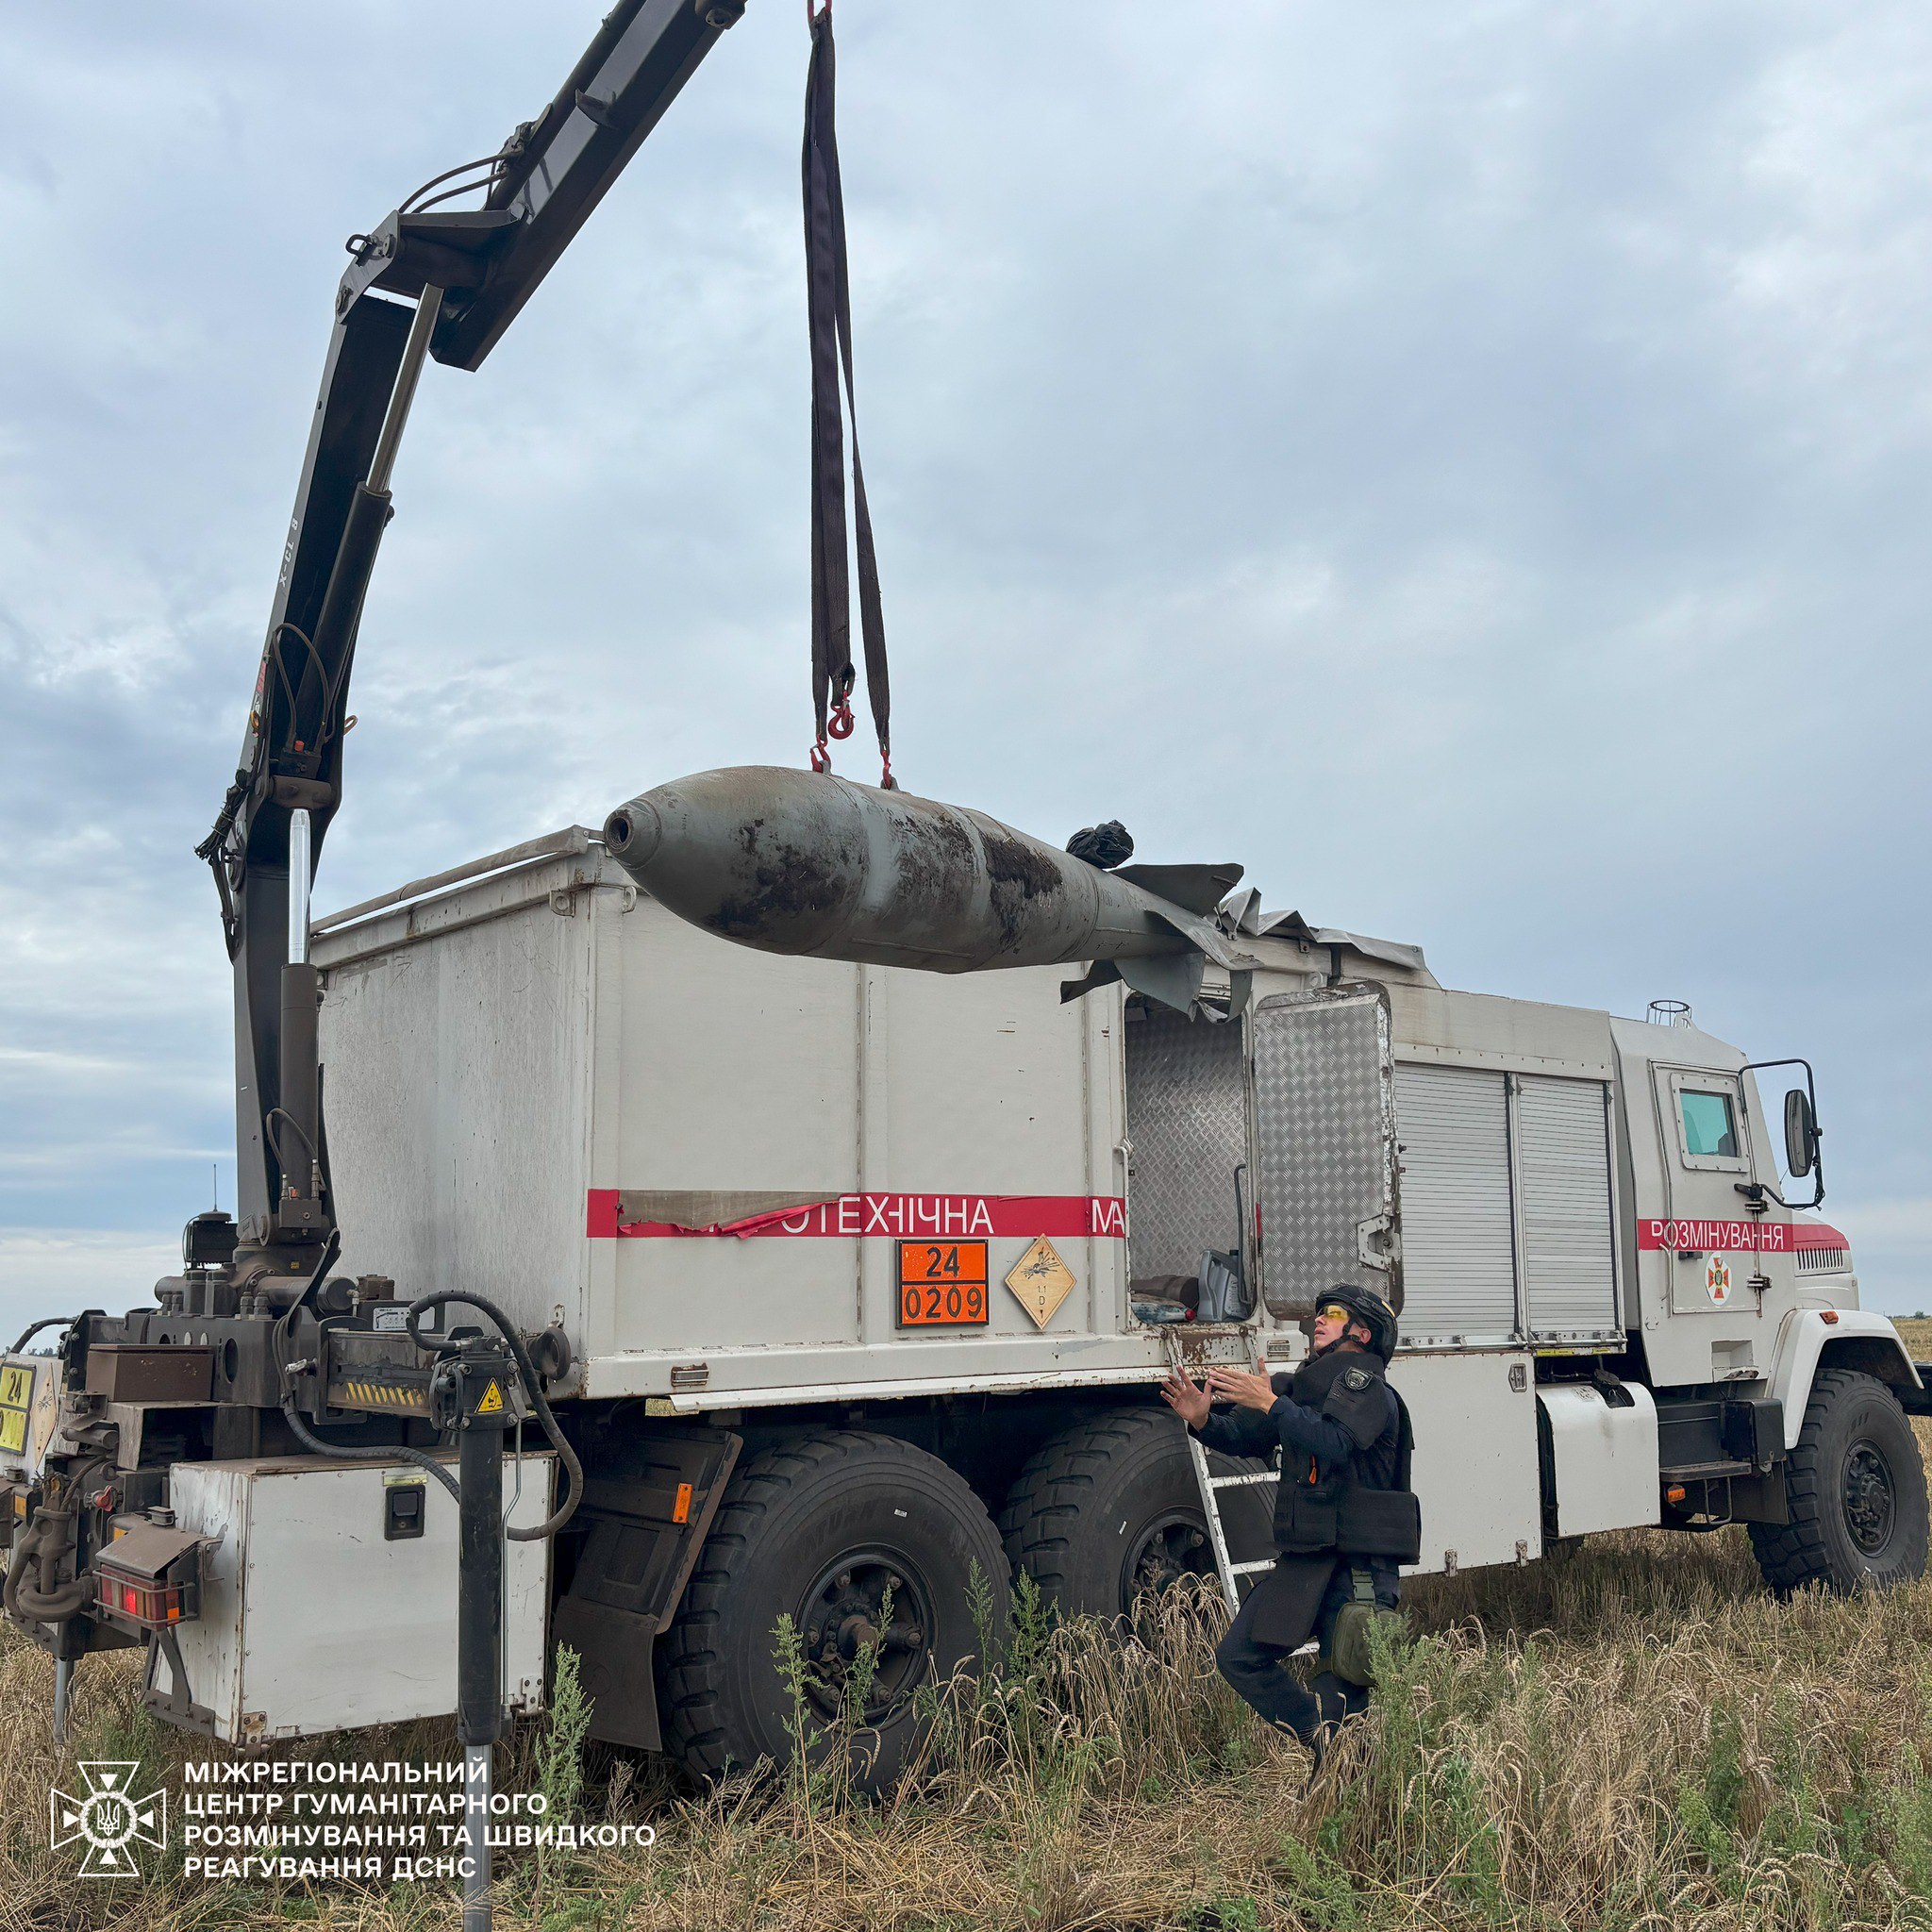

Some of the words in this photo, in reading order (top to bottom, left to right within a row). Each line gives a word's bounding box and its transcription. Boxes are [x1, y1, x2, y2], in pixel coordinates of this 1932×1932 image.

[926, 1246, 959, 1277] 24
[906, 1286, 982, 1319] 0209
[1038, 1285, 1047, 1293] 1.1
[1039, 1295, 1046, 1306] D
[8, 1371, 23, 1404] 24
